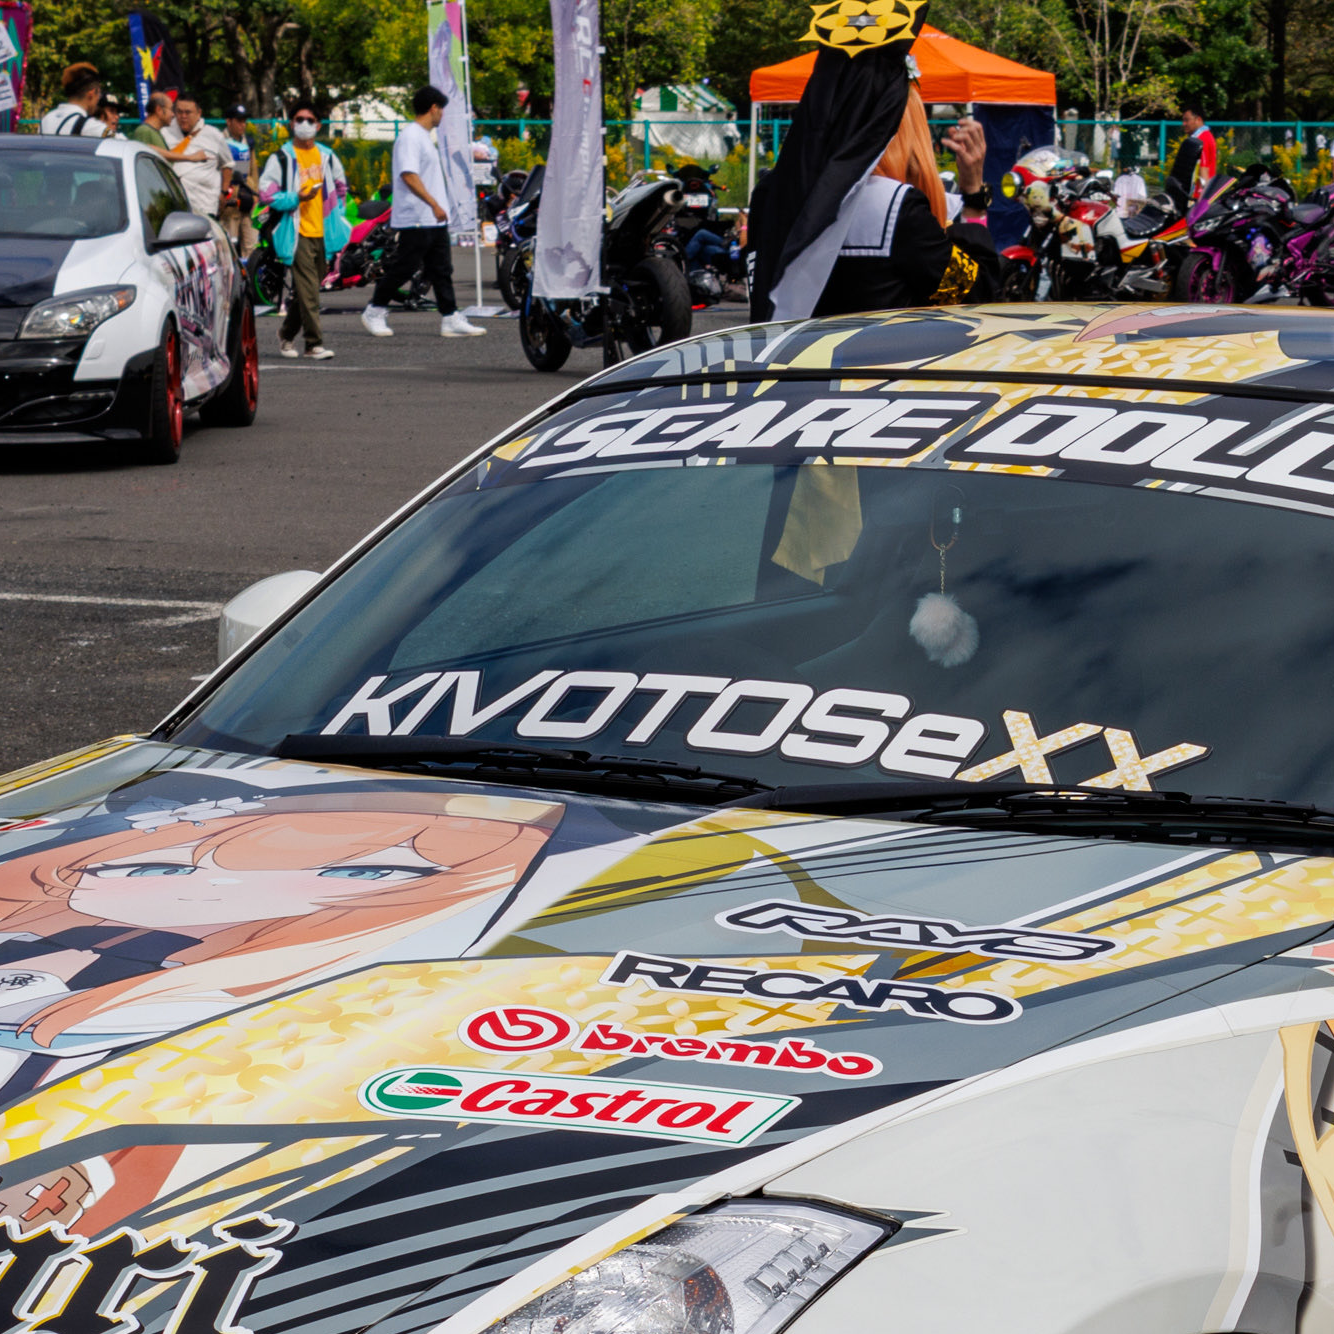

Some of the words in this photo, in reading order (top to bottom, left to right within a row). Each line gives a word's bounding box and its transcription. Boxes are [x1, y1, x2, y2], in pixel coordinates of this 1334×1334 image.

[726, 902, 1116, 961] RAYS
[608, 954, 1014, 1021] RECARO
[580, 1024, 874, 1075] brembo
[460, 1079, 753, 1134] Castrol
